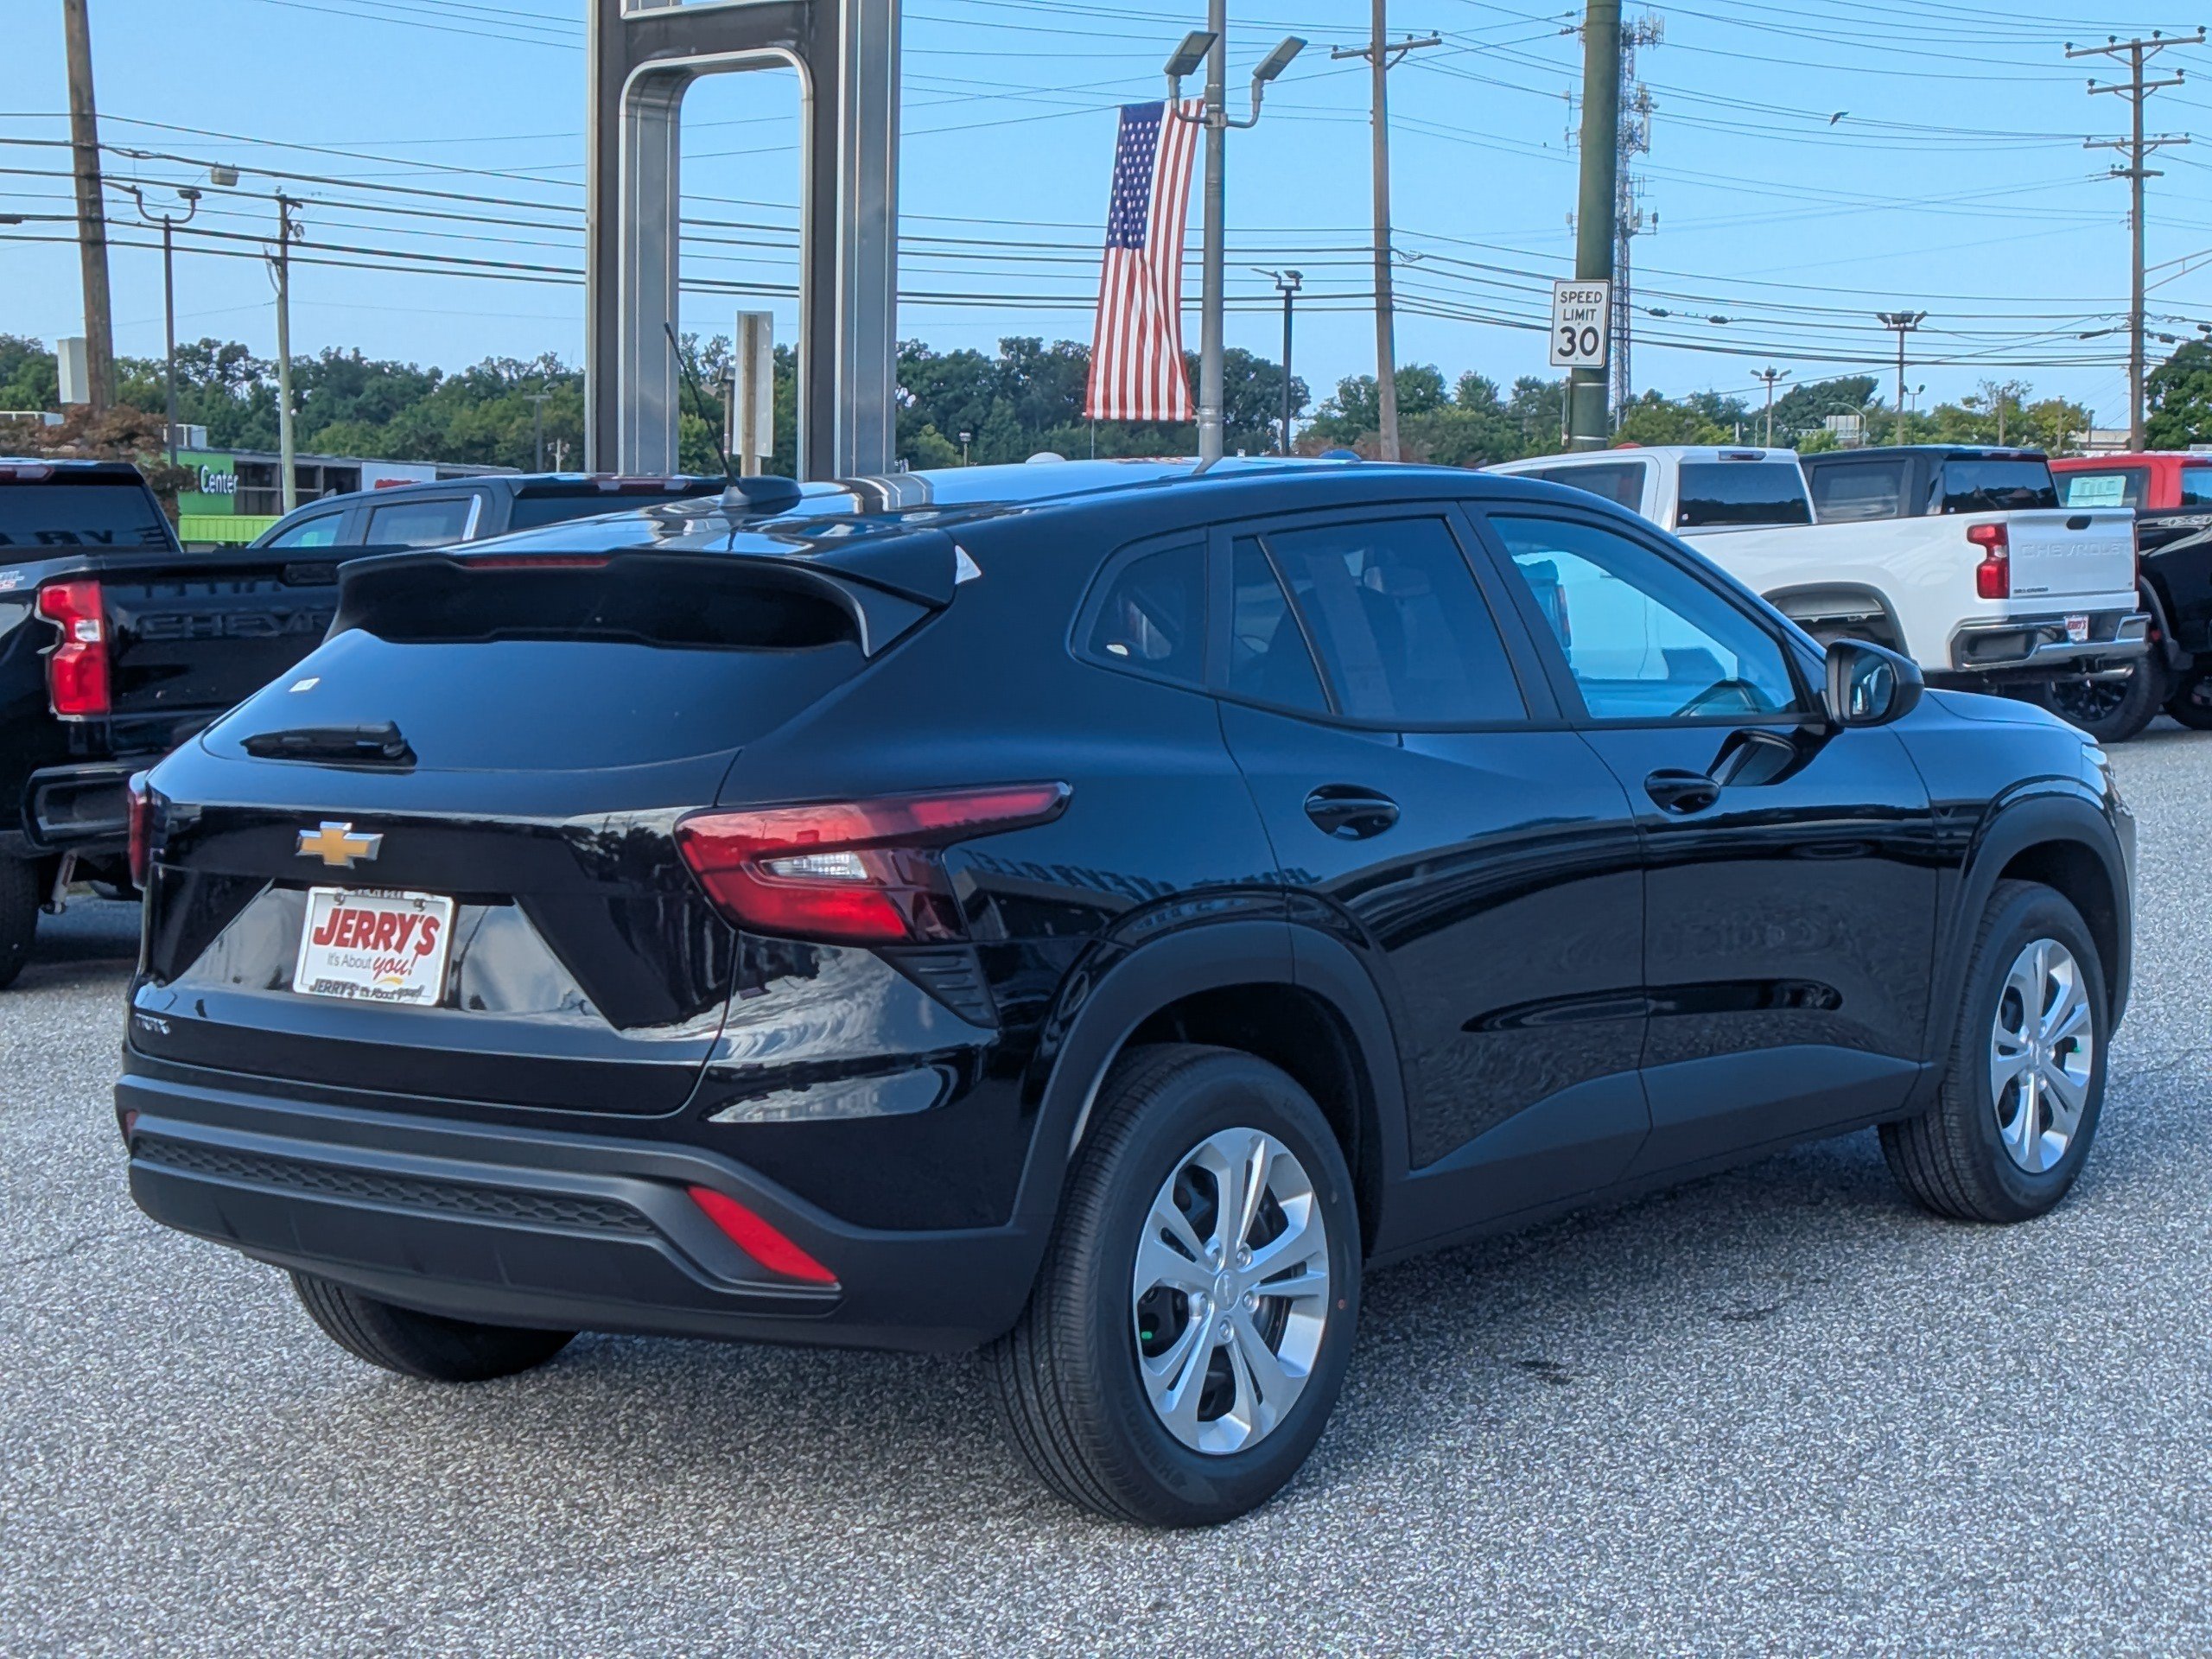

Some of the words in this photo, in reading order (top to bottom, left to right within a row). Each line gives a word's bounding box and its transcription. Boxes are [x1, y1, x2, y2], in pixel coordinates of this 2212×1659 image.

[200, 464, 239, 493] Center
[312, 907, 441, 956] JERRY'S
[327, 951, 340, 966] It's
[341, 954, 372, 969] About
[372, 951, 419, 981] you!
[1560, 1155, 1603, 1168] SPEED
[1562, 1173, 1597, 1185] LIMIT
[1557, 1190, 1599, 1221] 30
